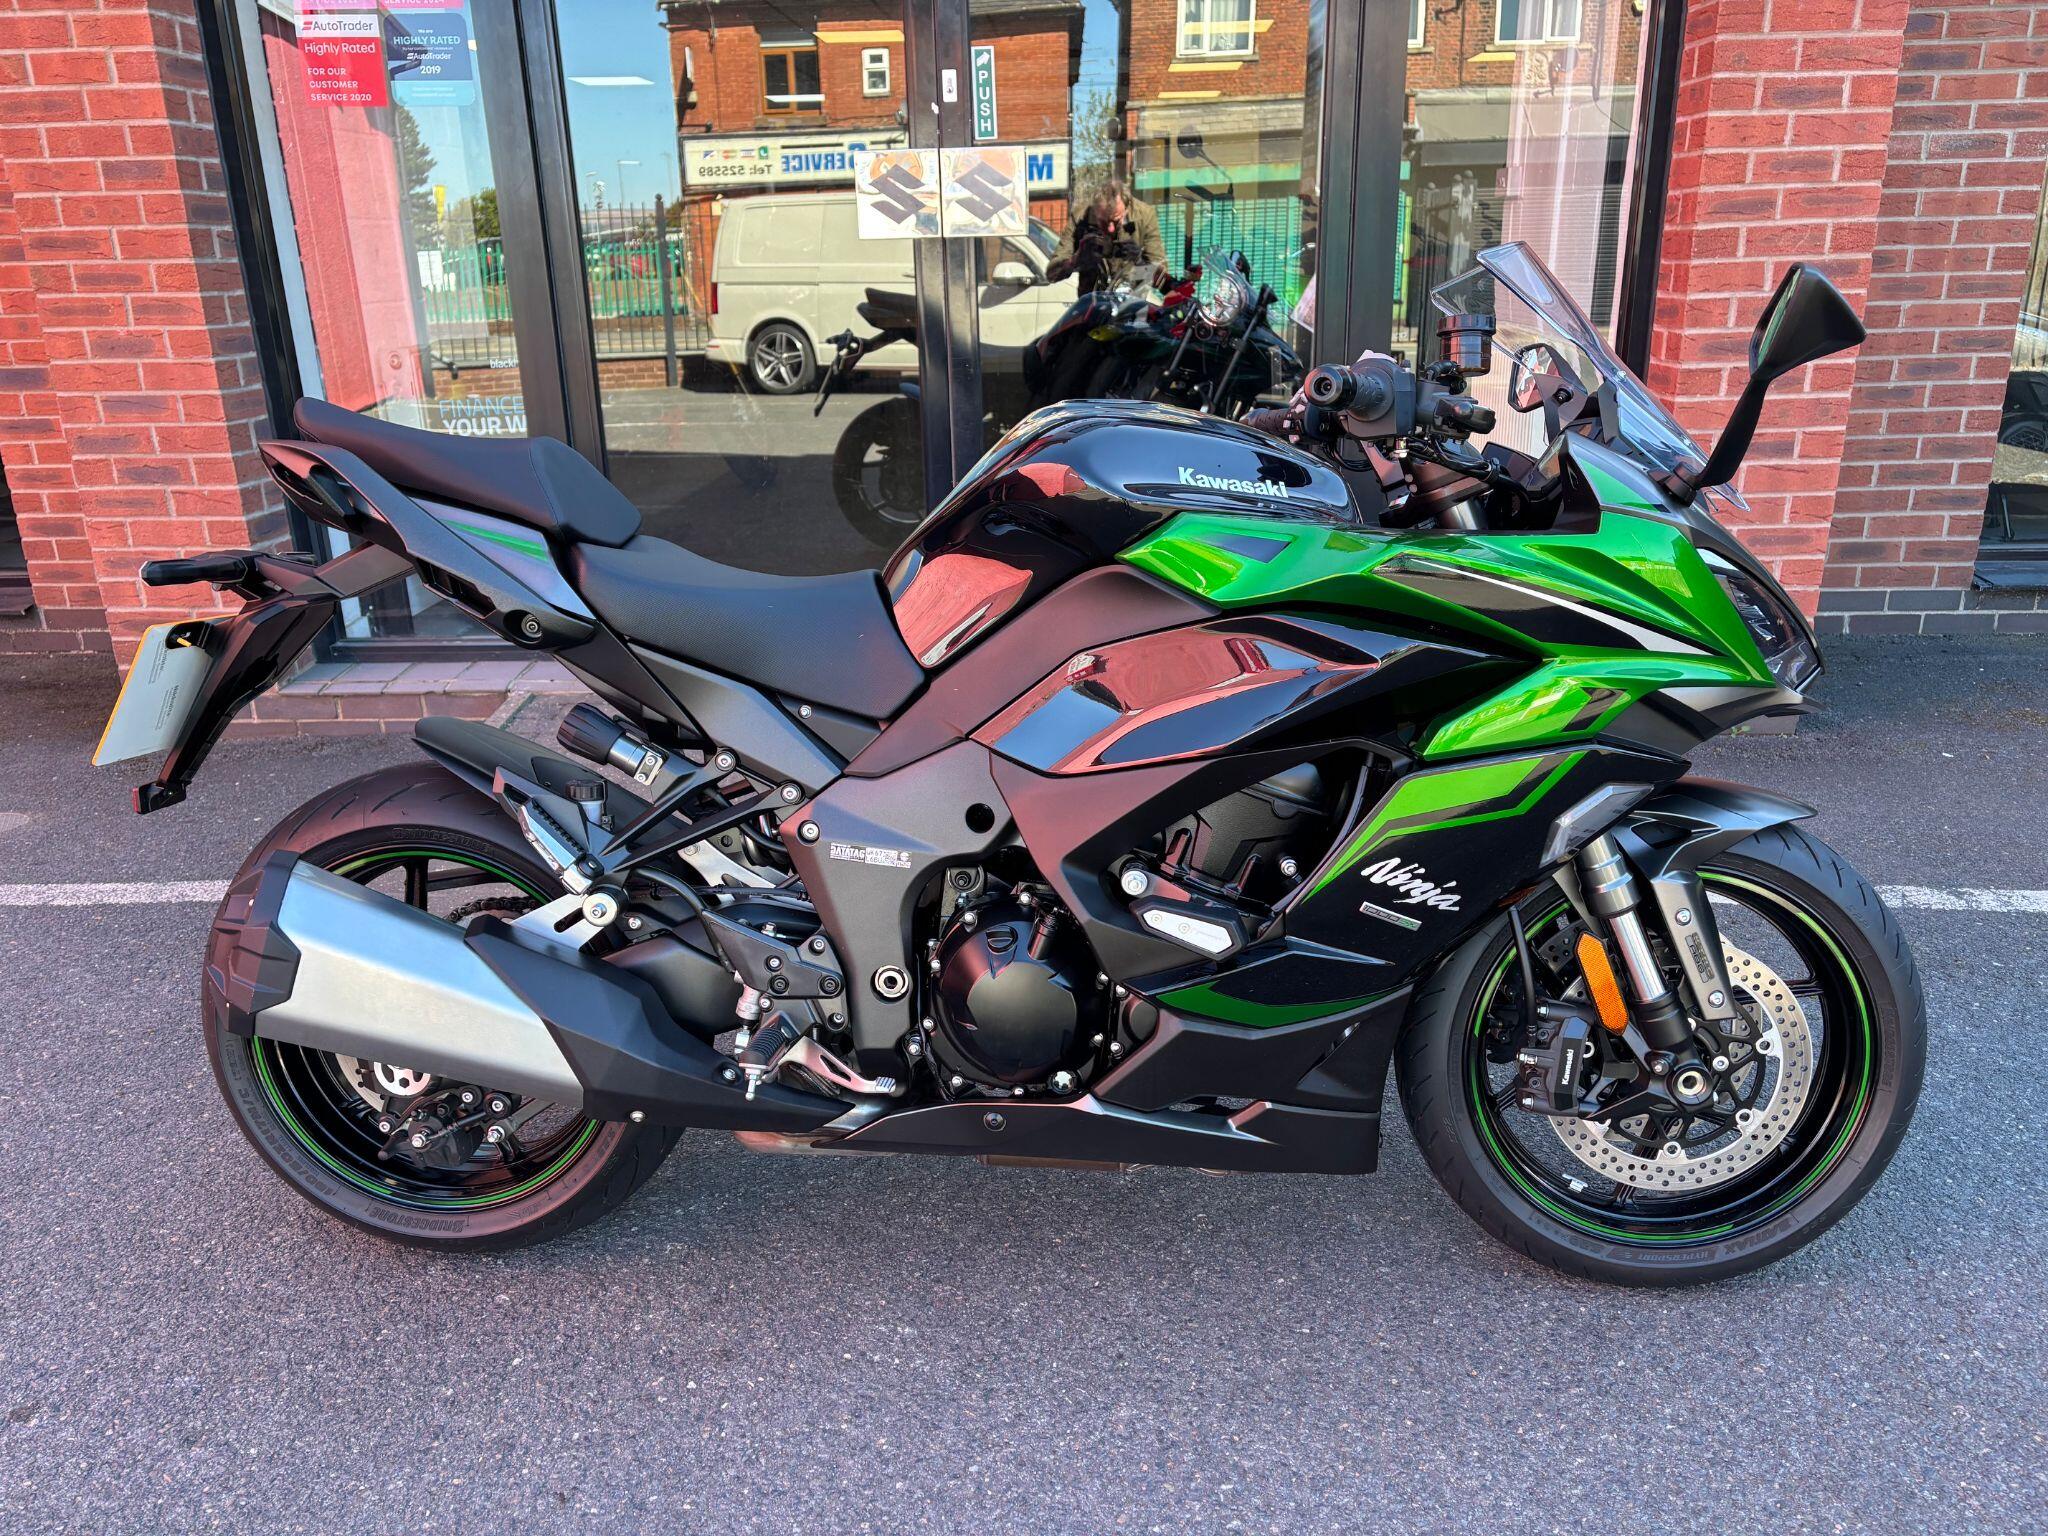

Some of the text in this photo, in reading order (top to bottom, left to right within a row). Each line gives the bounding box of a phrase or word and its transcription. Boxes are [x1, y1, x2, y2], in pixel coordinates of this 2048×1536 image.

[312, 20, 374, 32] AutoTrader
[393, 36, 461, 45] HIGHLY RATED
[304, 42, 376, 56] Highly Rated
[307, 67, 347, 76] FOR OUR
[420, 65, 441, 75] 2019
[309, 80, 359, 89] CUSTOMER
[310, 93, 372, 102] SERVICE 2020
[978, 70, 992, 132] PUSH
[439, 397, 524, 417] FINANCE
[442, 416, 501, 436] YOUR
[1178, 466, 1290, 499] Kawasaki
[1360, 857, 1462, 911] Ninja
[368, 1206, 467, 1233] BRIDGESTONE
